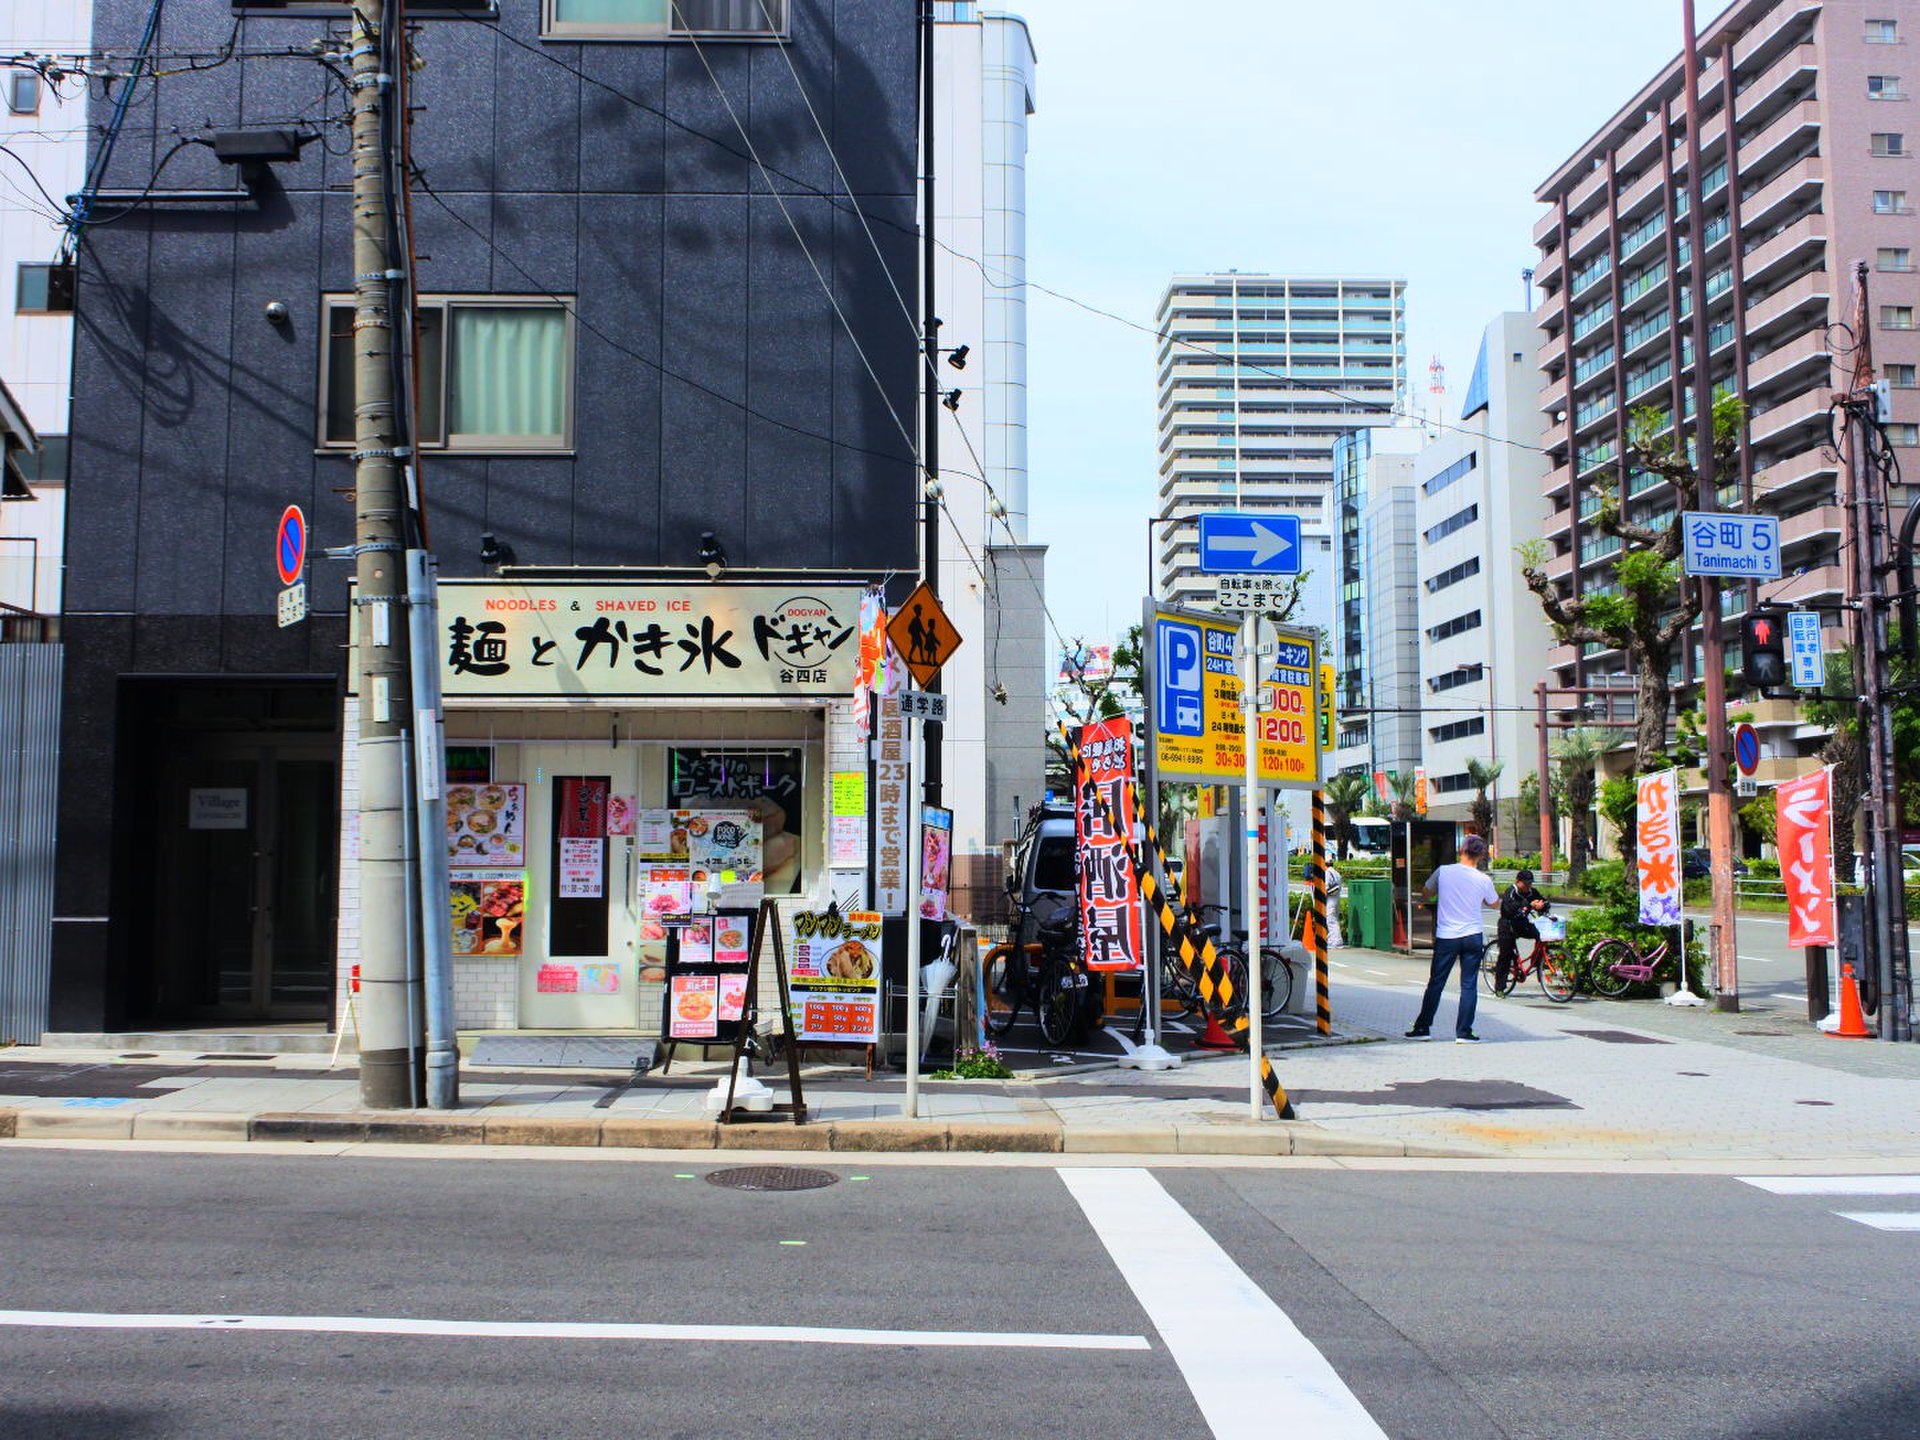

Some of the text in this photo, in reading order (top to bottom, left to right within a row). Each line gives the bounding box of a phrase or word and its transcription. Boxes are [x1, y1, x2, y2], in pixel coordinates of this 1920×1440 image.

[1692, 521, 1771, 551] 谷町 5
[1695, 552, 1771, 570] Tanimachi 5
[1220, 579, 1282, 590] 自転車を除く
[485, 599, 691, 612] NOODLES & SHAVED ICE
[1220, 592, 1283, 608] ここまで
[787, 608, 827, 618] DOGYAN
[1207, 631, 1237, 654] 谷町4
[780, 668, 828, 684] 谷四店
[901, 694, 944, 716] 通学路
